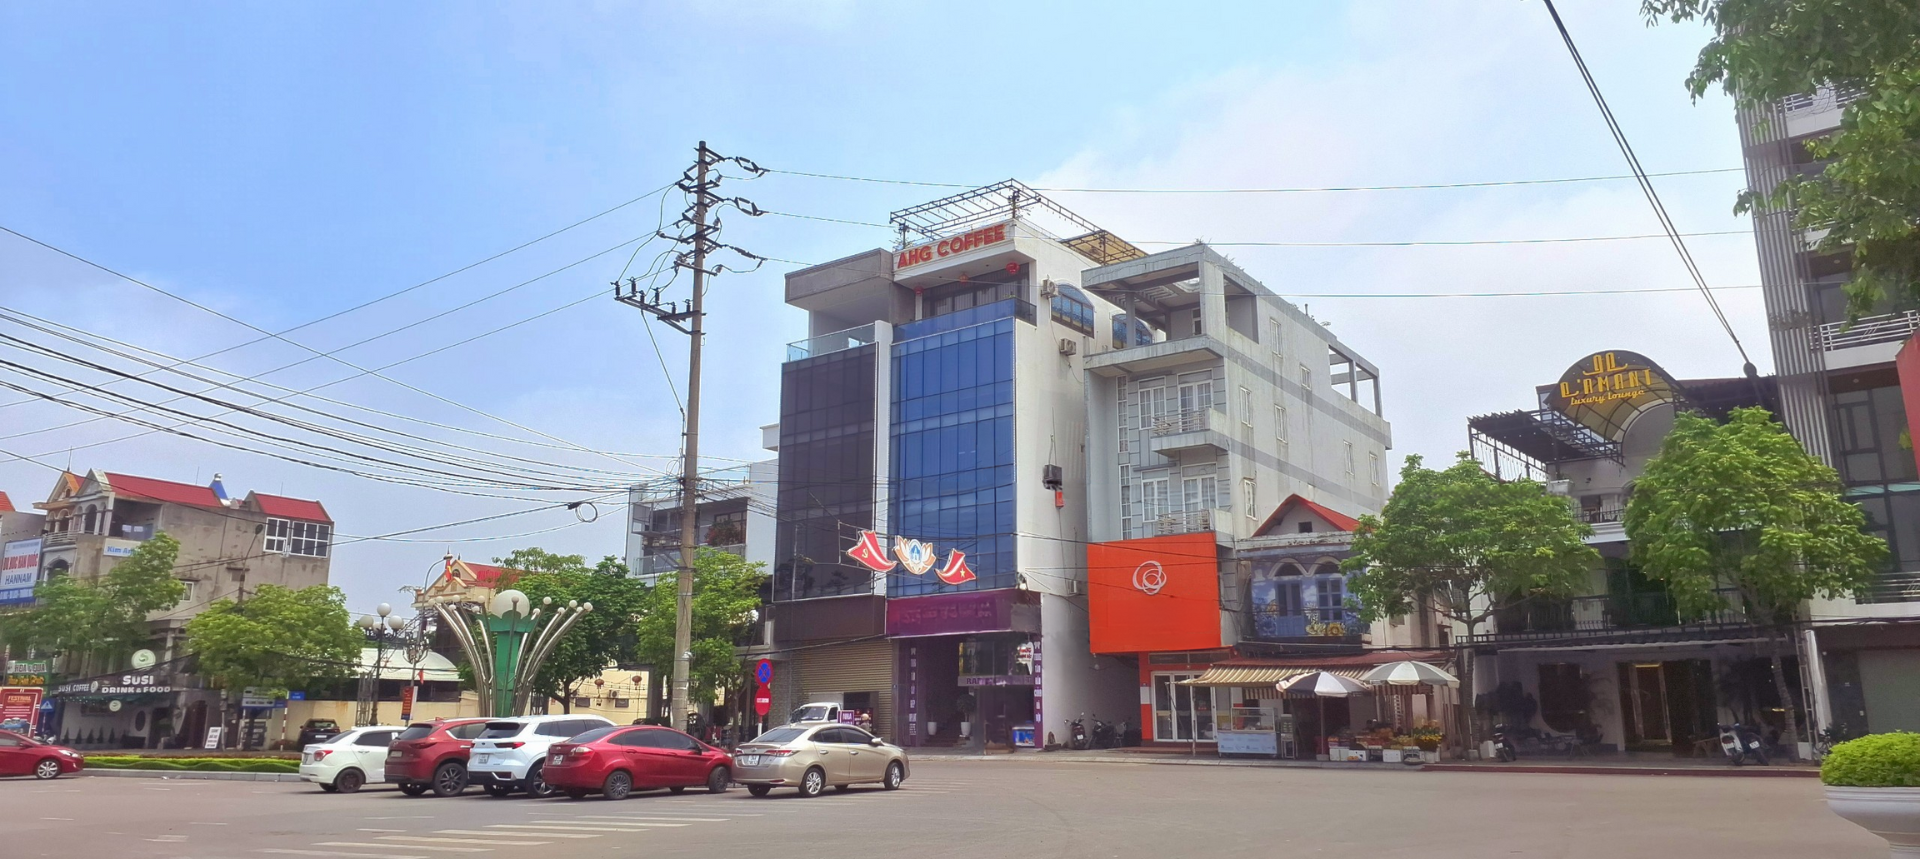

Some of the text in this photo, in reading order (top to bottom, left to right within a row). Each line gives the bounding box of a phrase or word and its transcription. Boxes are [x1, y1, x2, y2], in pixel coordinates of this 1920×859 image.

[897, 224, 1006, 269] AHG COFFEE
[5, 573, 32, 585] HANNAM
[122, 675, 154, 685] SUSI
[73, 683, 90, 692] COFFEE
